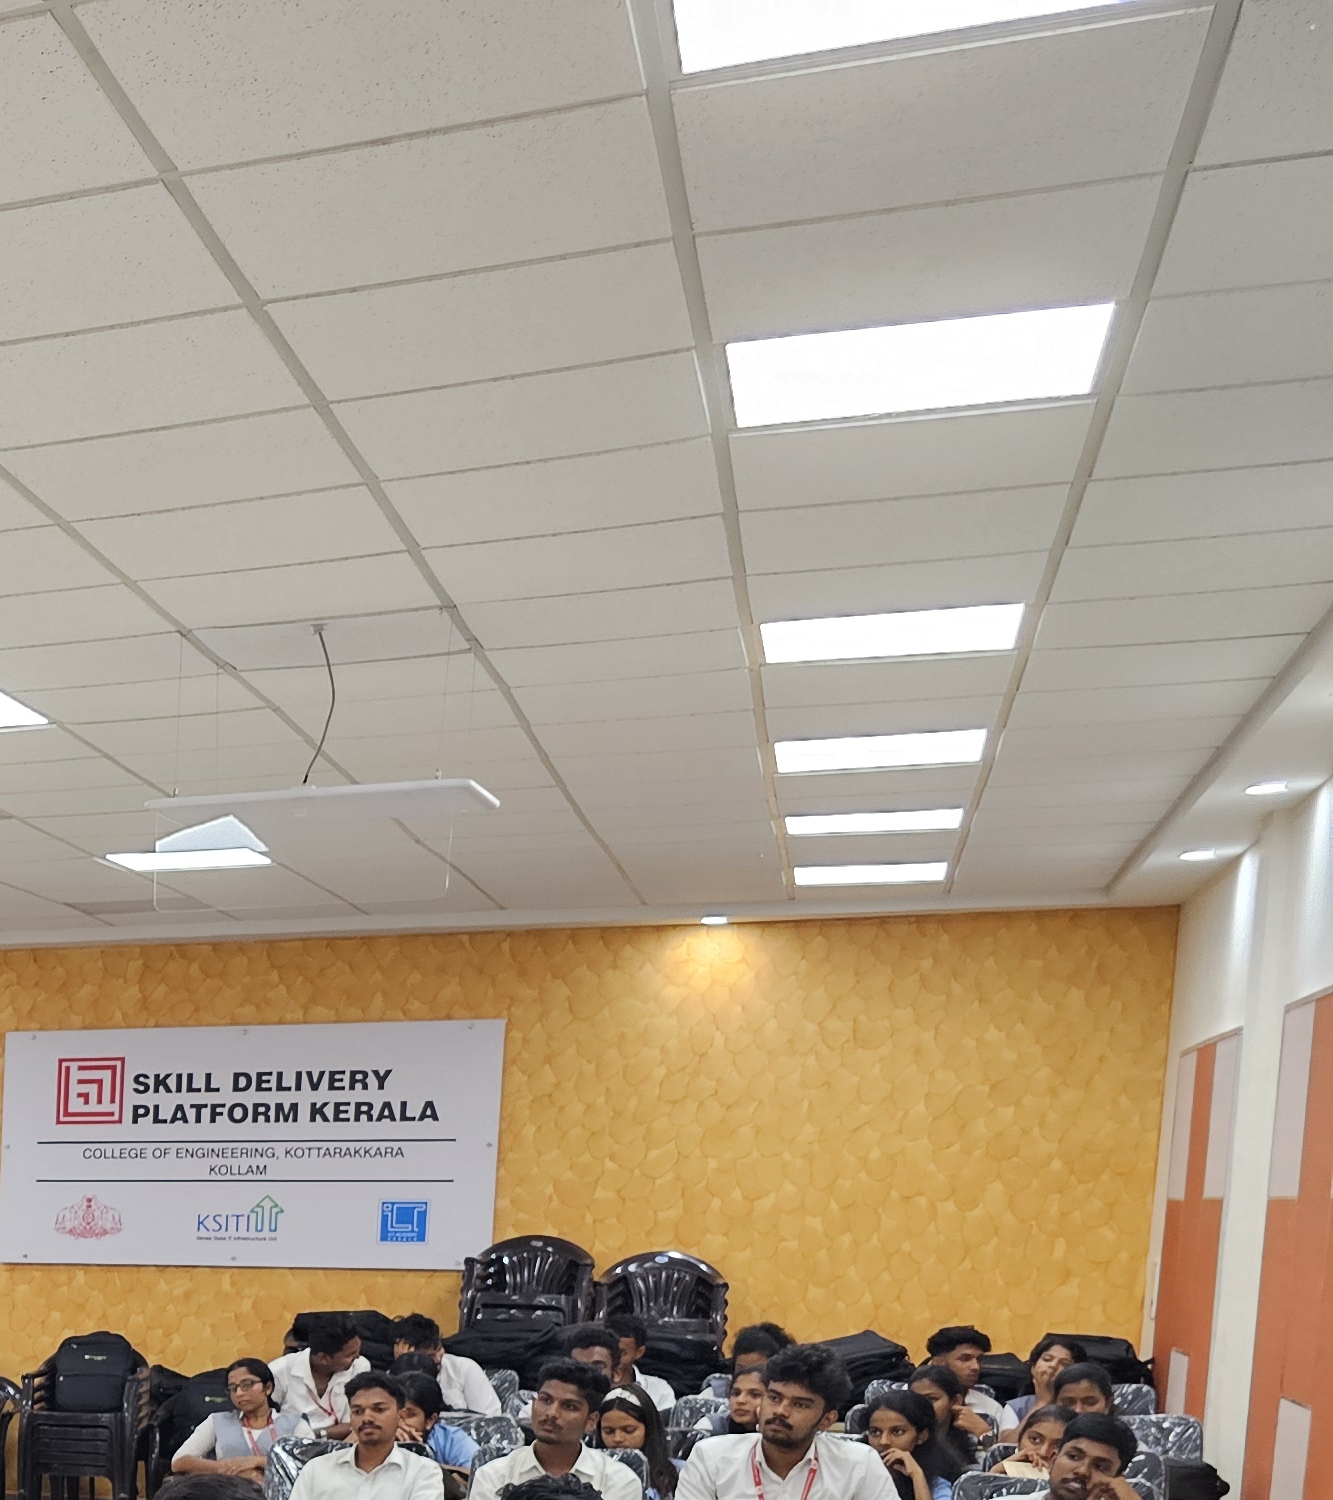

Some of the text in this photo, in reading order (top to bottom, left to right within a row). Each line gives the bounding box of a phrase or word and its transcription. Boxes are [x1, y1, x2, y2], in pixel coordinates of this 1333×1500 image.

[132, 1068, 395, 1094] SKILL DELIVERY
[131, 1100, 440, 1125] PLATFORM KERALA
[82, 1147, 405, 1161] COLLEGE OF ENGINEERING, KOTTARAKKARA
[208, 1164, 267, 1177] KOLLAM
